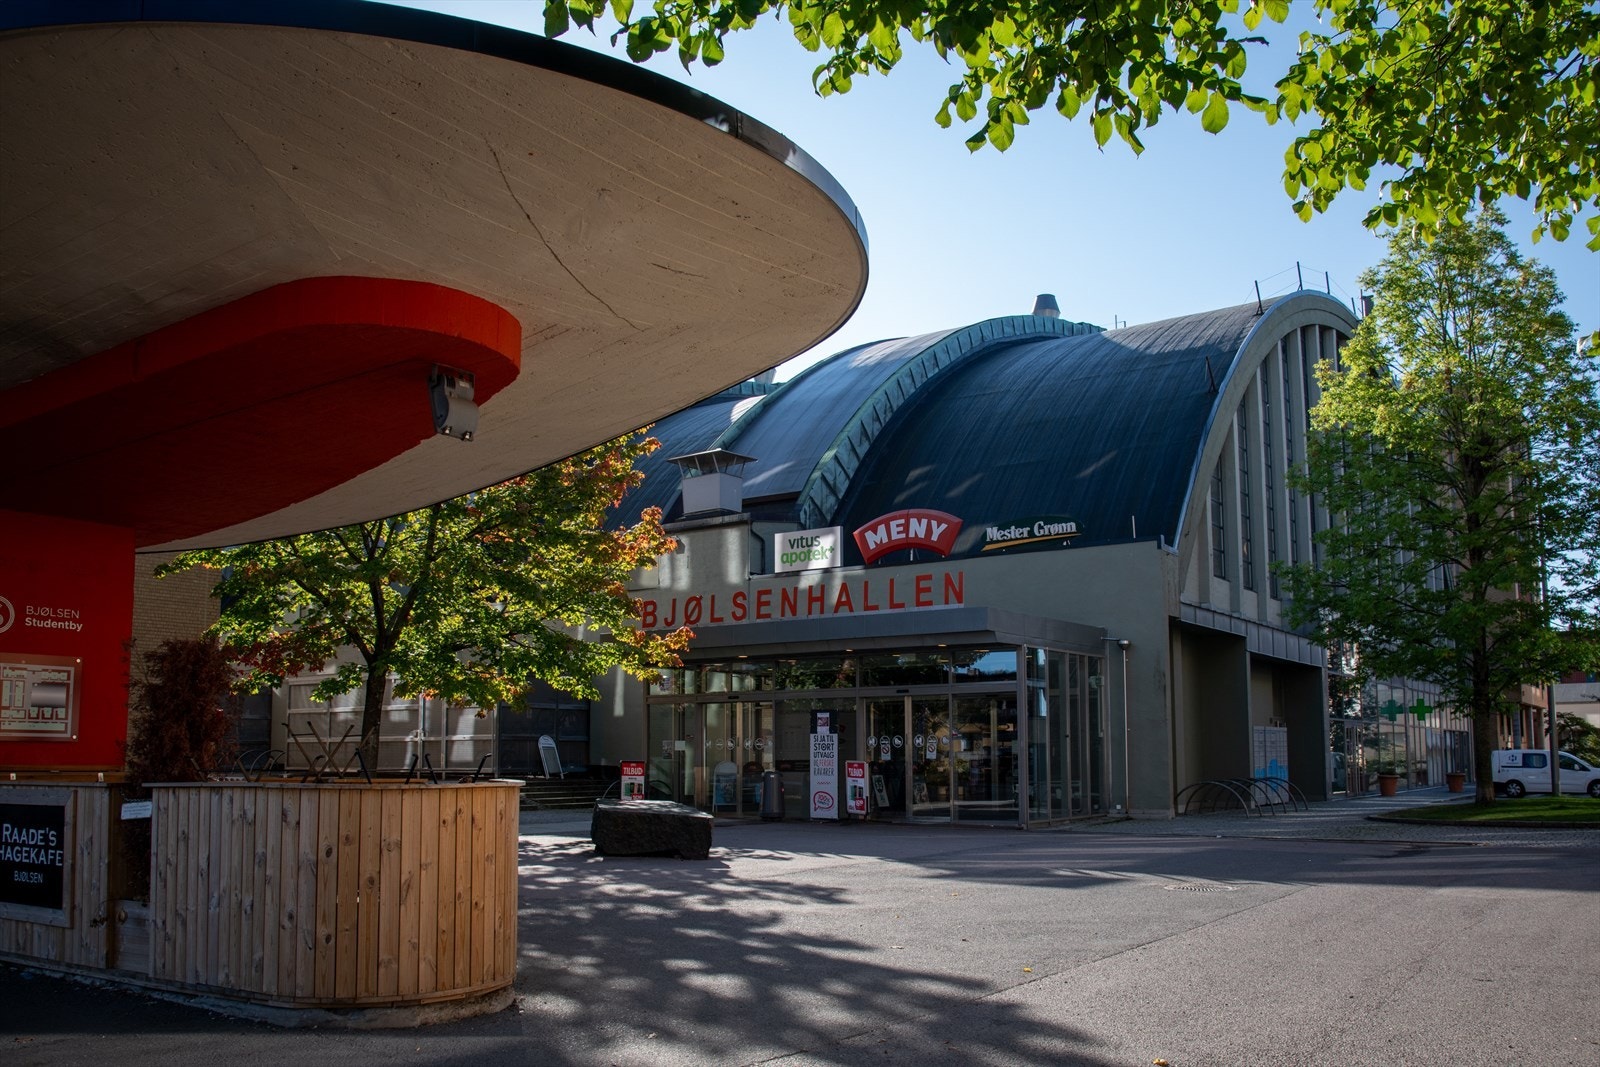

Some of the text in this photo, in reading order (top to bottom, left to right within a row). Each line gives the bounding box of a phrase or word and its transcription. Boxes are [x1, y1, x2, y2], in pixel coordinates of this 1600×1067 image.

[864, 517, 948, 550] MENY
[986, 520, 1077, 541] Mester Grønn
[788, 535, 821, 550] vitus
[641, 571, 965, 629] BJØLSENHALLEN
[26, 605, 80, 619] BJØLSEN
[25, 617, 83, 632] Studentby
[813, 743, 834, 751] STORT
[623, 767, 643, 775] TILBUD
[2, 823, 57, 847] RAADE'S
[0, 845, 64, 867] HAGEKAFE
[14, 870, 44, 884] BJØLSEN
